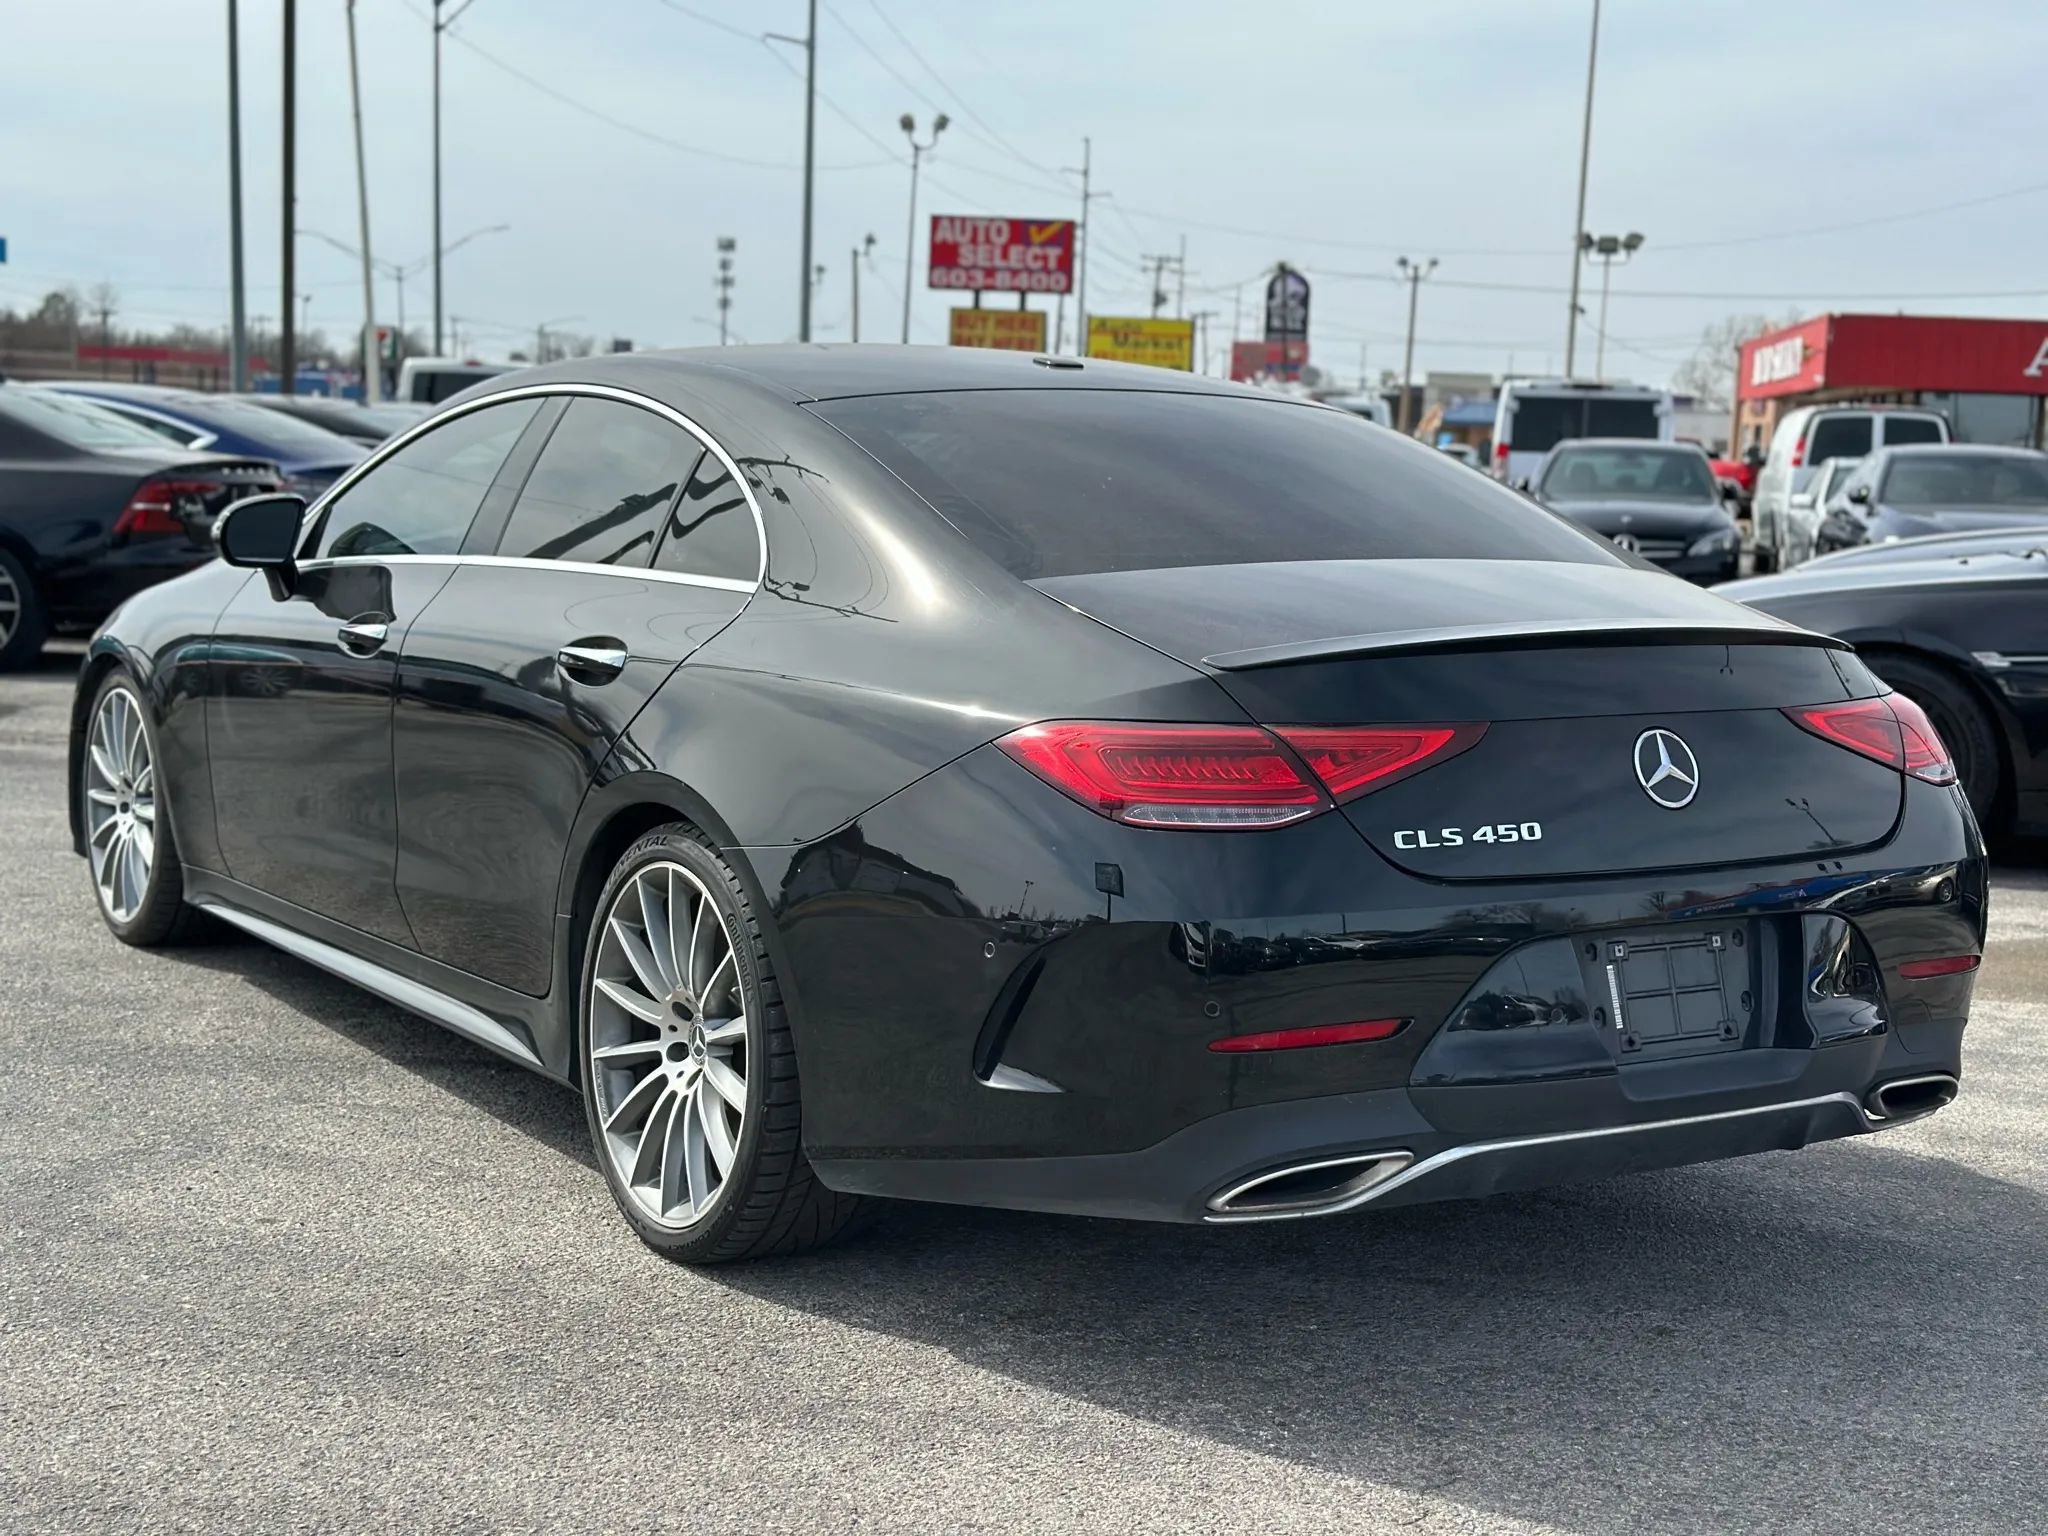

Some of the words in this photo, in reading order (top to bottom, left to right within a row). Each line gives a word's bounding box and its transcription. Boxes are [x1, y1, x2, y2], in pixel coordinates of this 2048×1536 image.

[934, 217, 1010, 245] AUTO
[957, 243, 1063, 271] SELECT
[931, 266, 1068, 291] 603-8400
[1393, 827, 1464, 850] CLS
[1472, 821, 1542, 843] 450
